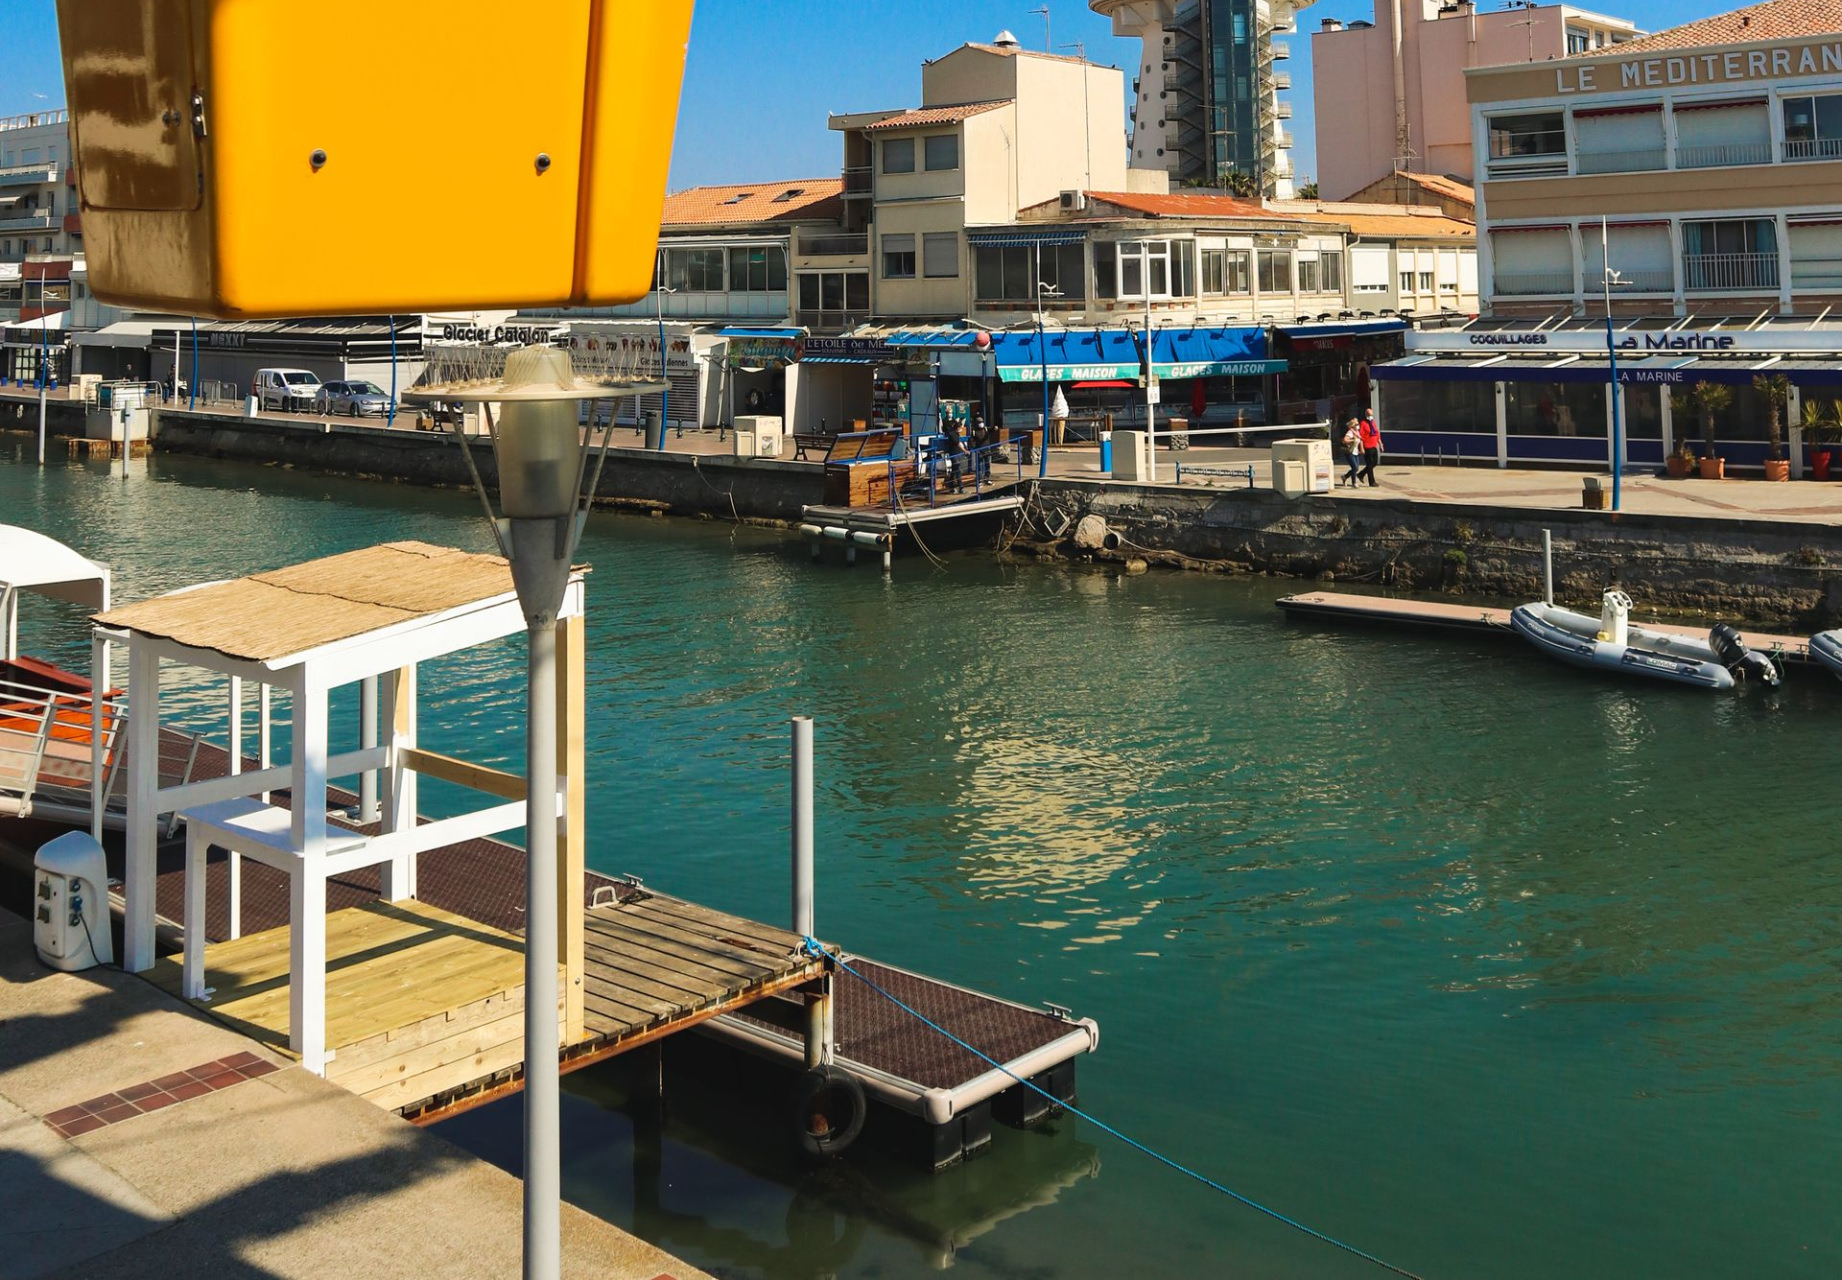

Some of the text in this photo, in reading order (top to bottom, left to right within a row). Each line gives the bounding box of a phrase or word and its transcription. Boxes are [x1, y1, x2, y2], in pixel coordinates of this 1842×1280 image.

[1556, 43, 1842, 93] LE MEDITERRAN
[443, 324, 550, 344] Glacier Catalan
[1469, 334, 1548, 345] COQUILLAGES
[851, 340, 864, 349] de
[1645, 332, 1736, 350] Marine
[1071, 367, 1118, 379] MAISON
[1171, 363, 1266, 378] GLACES MAISON
[1636, 371, 1683, 382] MARINE
